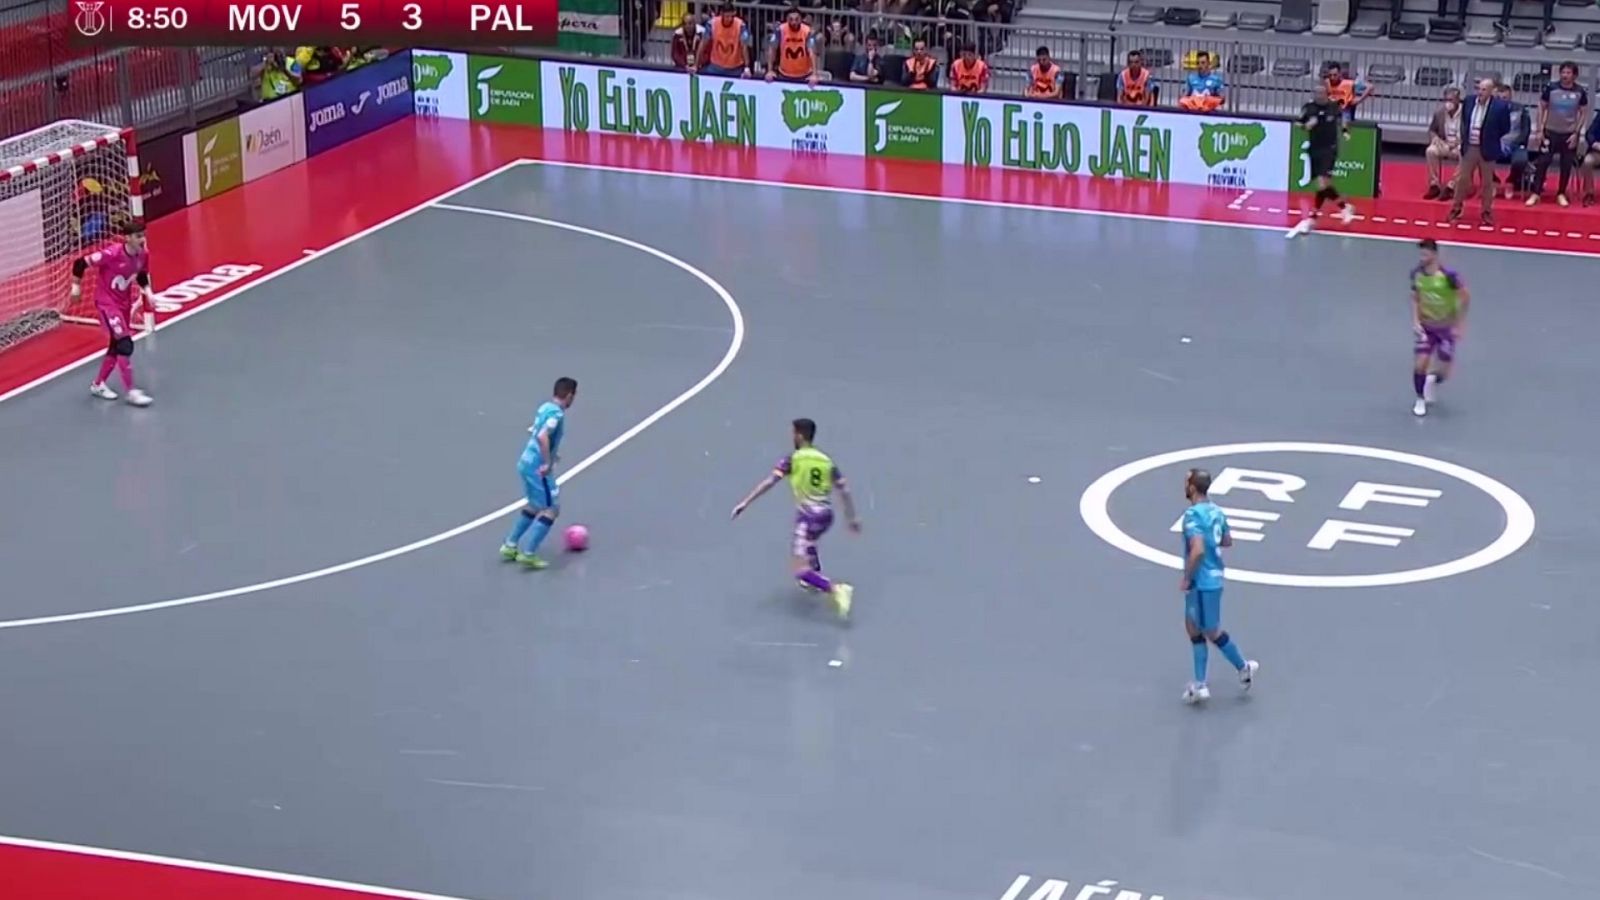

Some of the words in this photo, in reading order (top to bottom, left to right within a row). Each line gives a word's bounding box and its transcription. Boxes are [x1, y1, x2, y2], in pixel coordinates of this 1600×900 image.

[680, 74, 757, 146] JAÉN
[793, 98, 810, 119] 10
[1088, 109, 1171, 182] JAÉN
[1212, 132, 1229, 153] 10
[809, 467, 822, 487] 8
